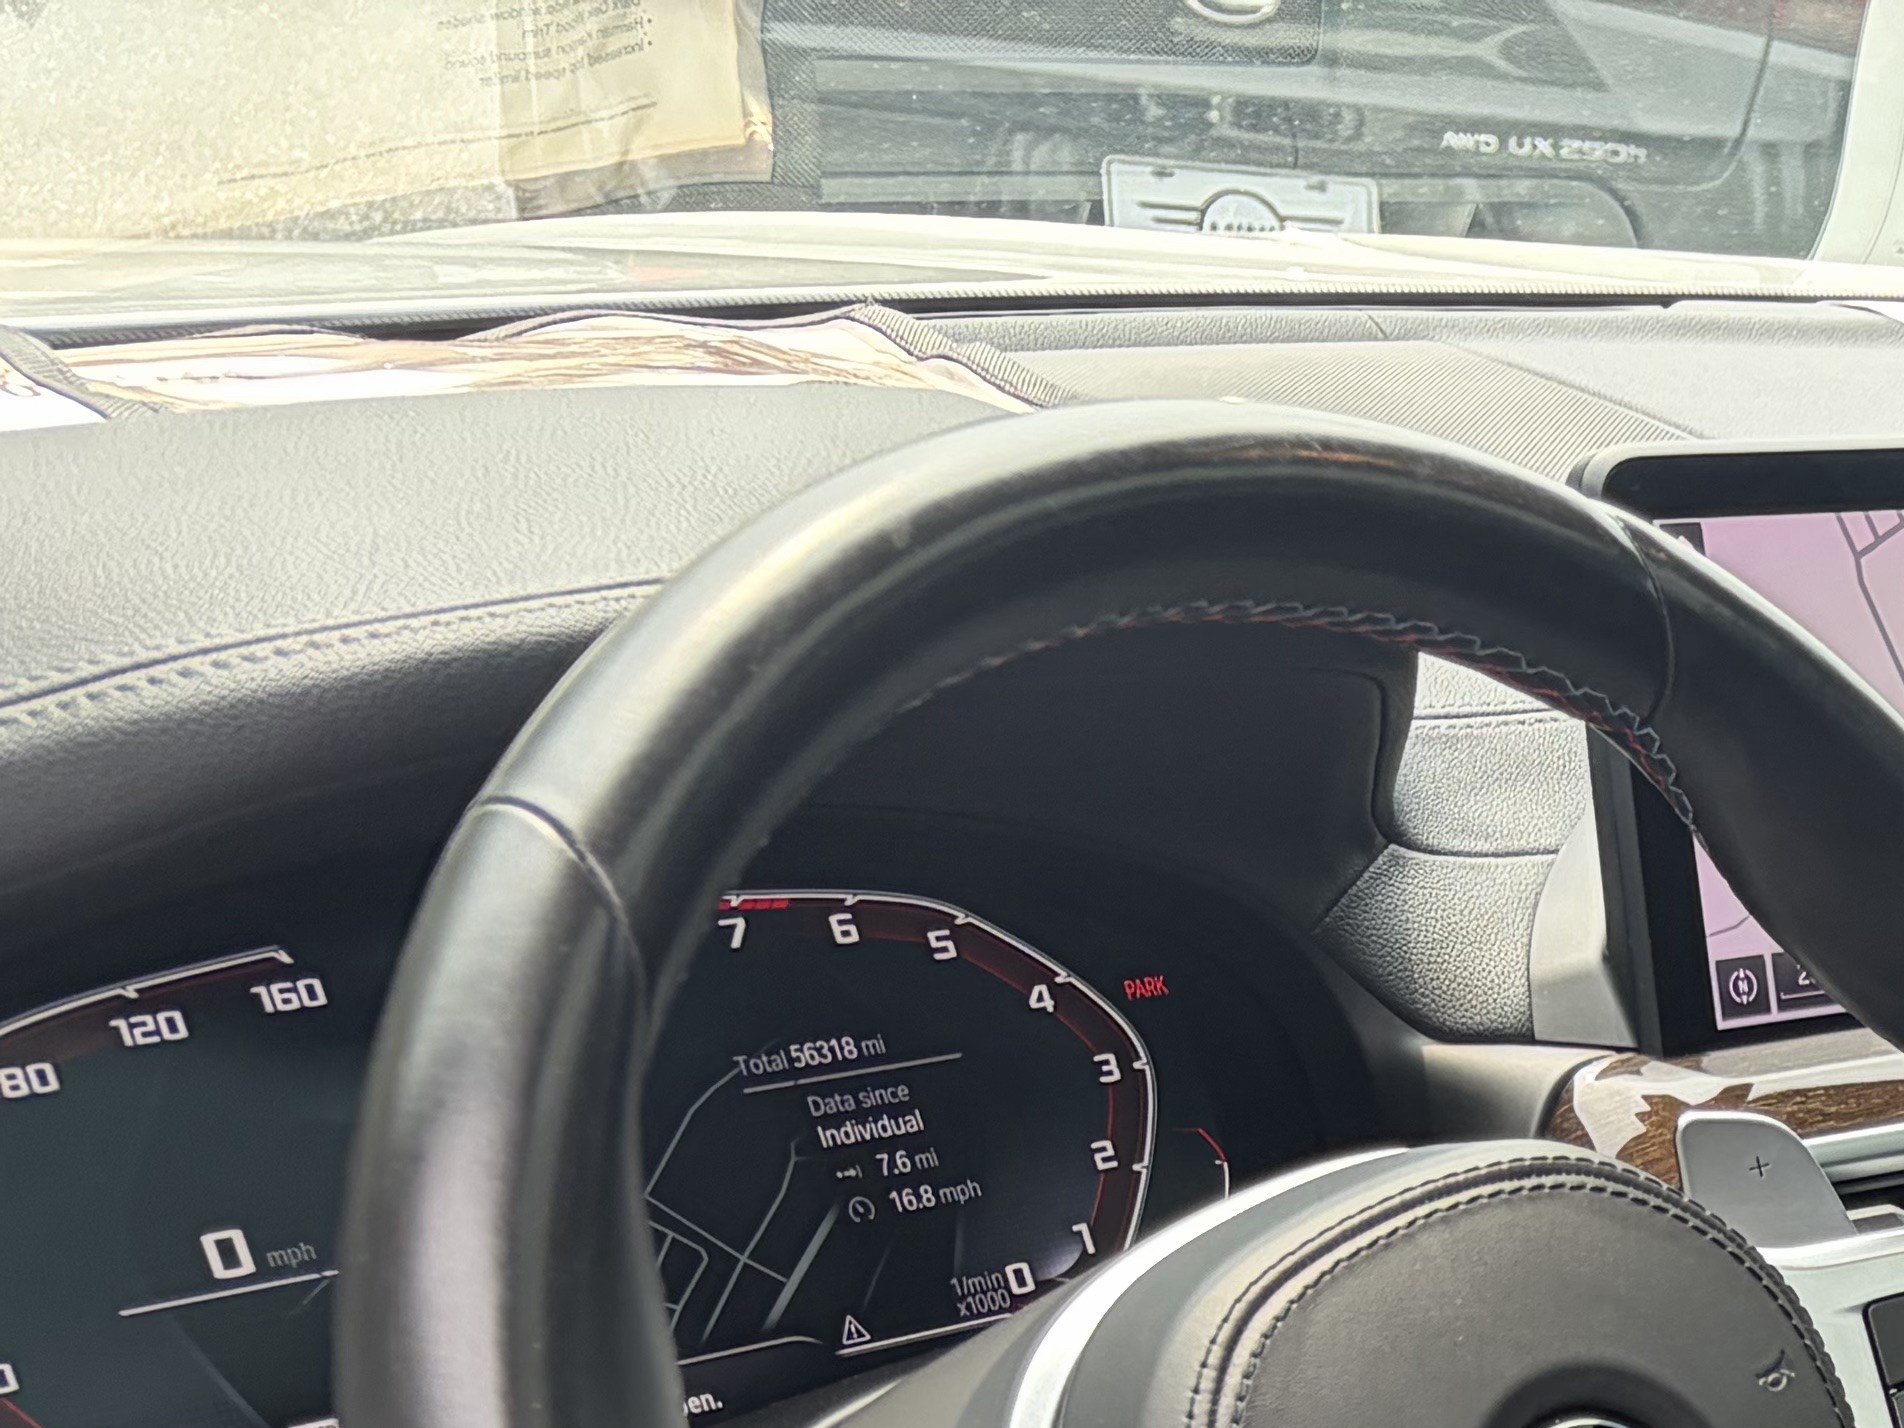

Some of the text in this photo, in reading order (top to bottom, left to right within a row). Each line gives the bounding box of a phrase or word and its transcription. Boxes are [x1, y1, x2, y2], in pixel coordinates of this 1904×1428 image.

[1440, 130, 1499, 155] AWD
[1507, 135, 1556, 158] UX
[716, 914, 748, 950] 7
[828, 912, 860, 945] 6
[926, 929, 957, 962] 5
[250, 977, 328, 1014] 160
[1028, 983, 1055, 1013] 4
[1123, 974, 1170, 1000] PARK
[109, 1009, 189, 1048] 120
[733, 1034, 887, 1077] Total 56318 mi
[1093, 1053, 1121, 1082] 3
[0, 1062, 60, 1098] 80
[806, 1081, 911, 1118] Data since
[816, 1109, 926, 1149] Individual
[875, 1146, 940, 1178] 7.6 mi
[1090, 1140, 1119, 1172] 2
[888, 1178, 982, 1215] 16.8 mph
[200, 1228, 318, 1280] 0 mph
[1071, 1222, 1097, 1256] 1
[949, 1269, 1005, 1299] 1/min
[1008, 1262, 1037, 1296] 0
[955, 1287, 1011, 1318] x1000
